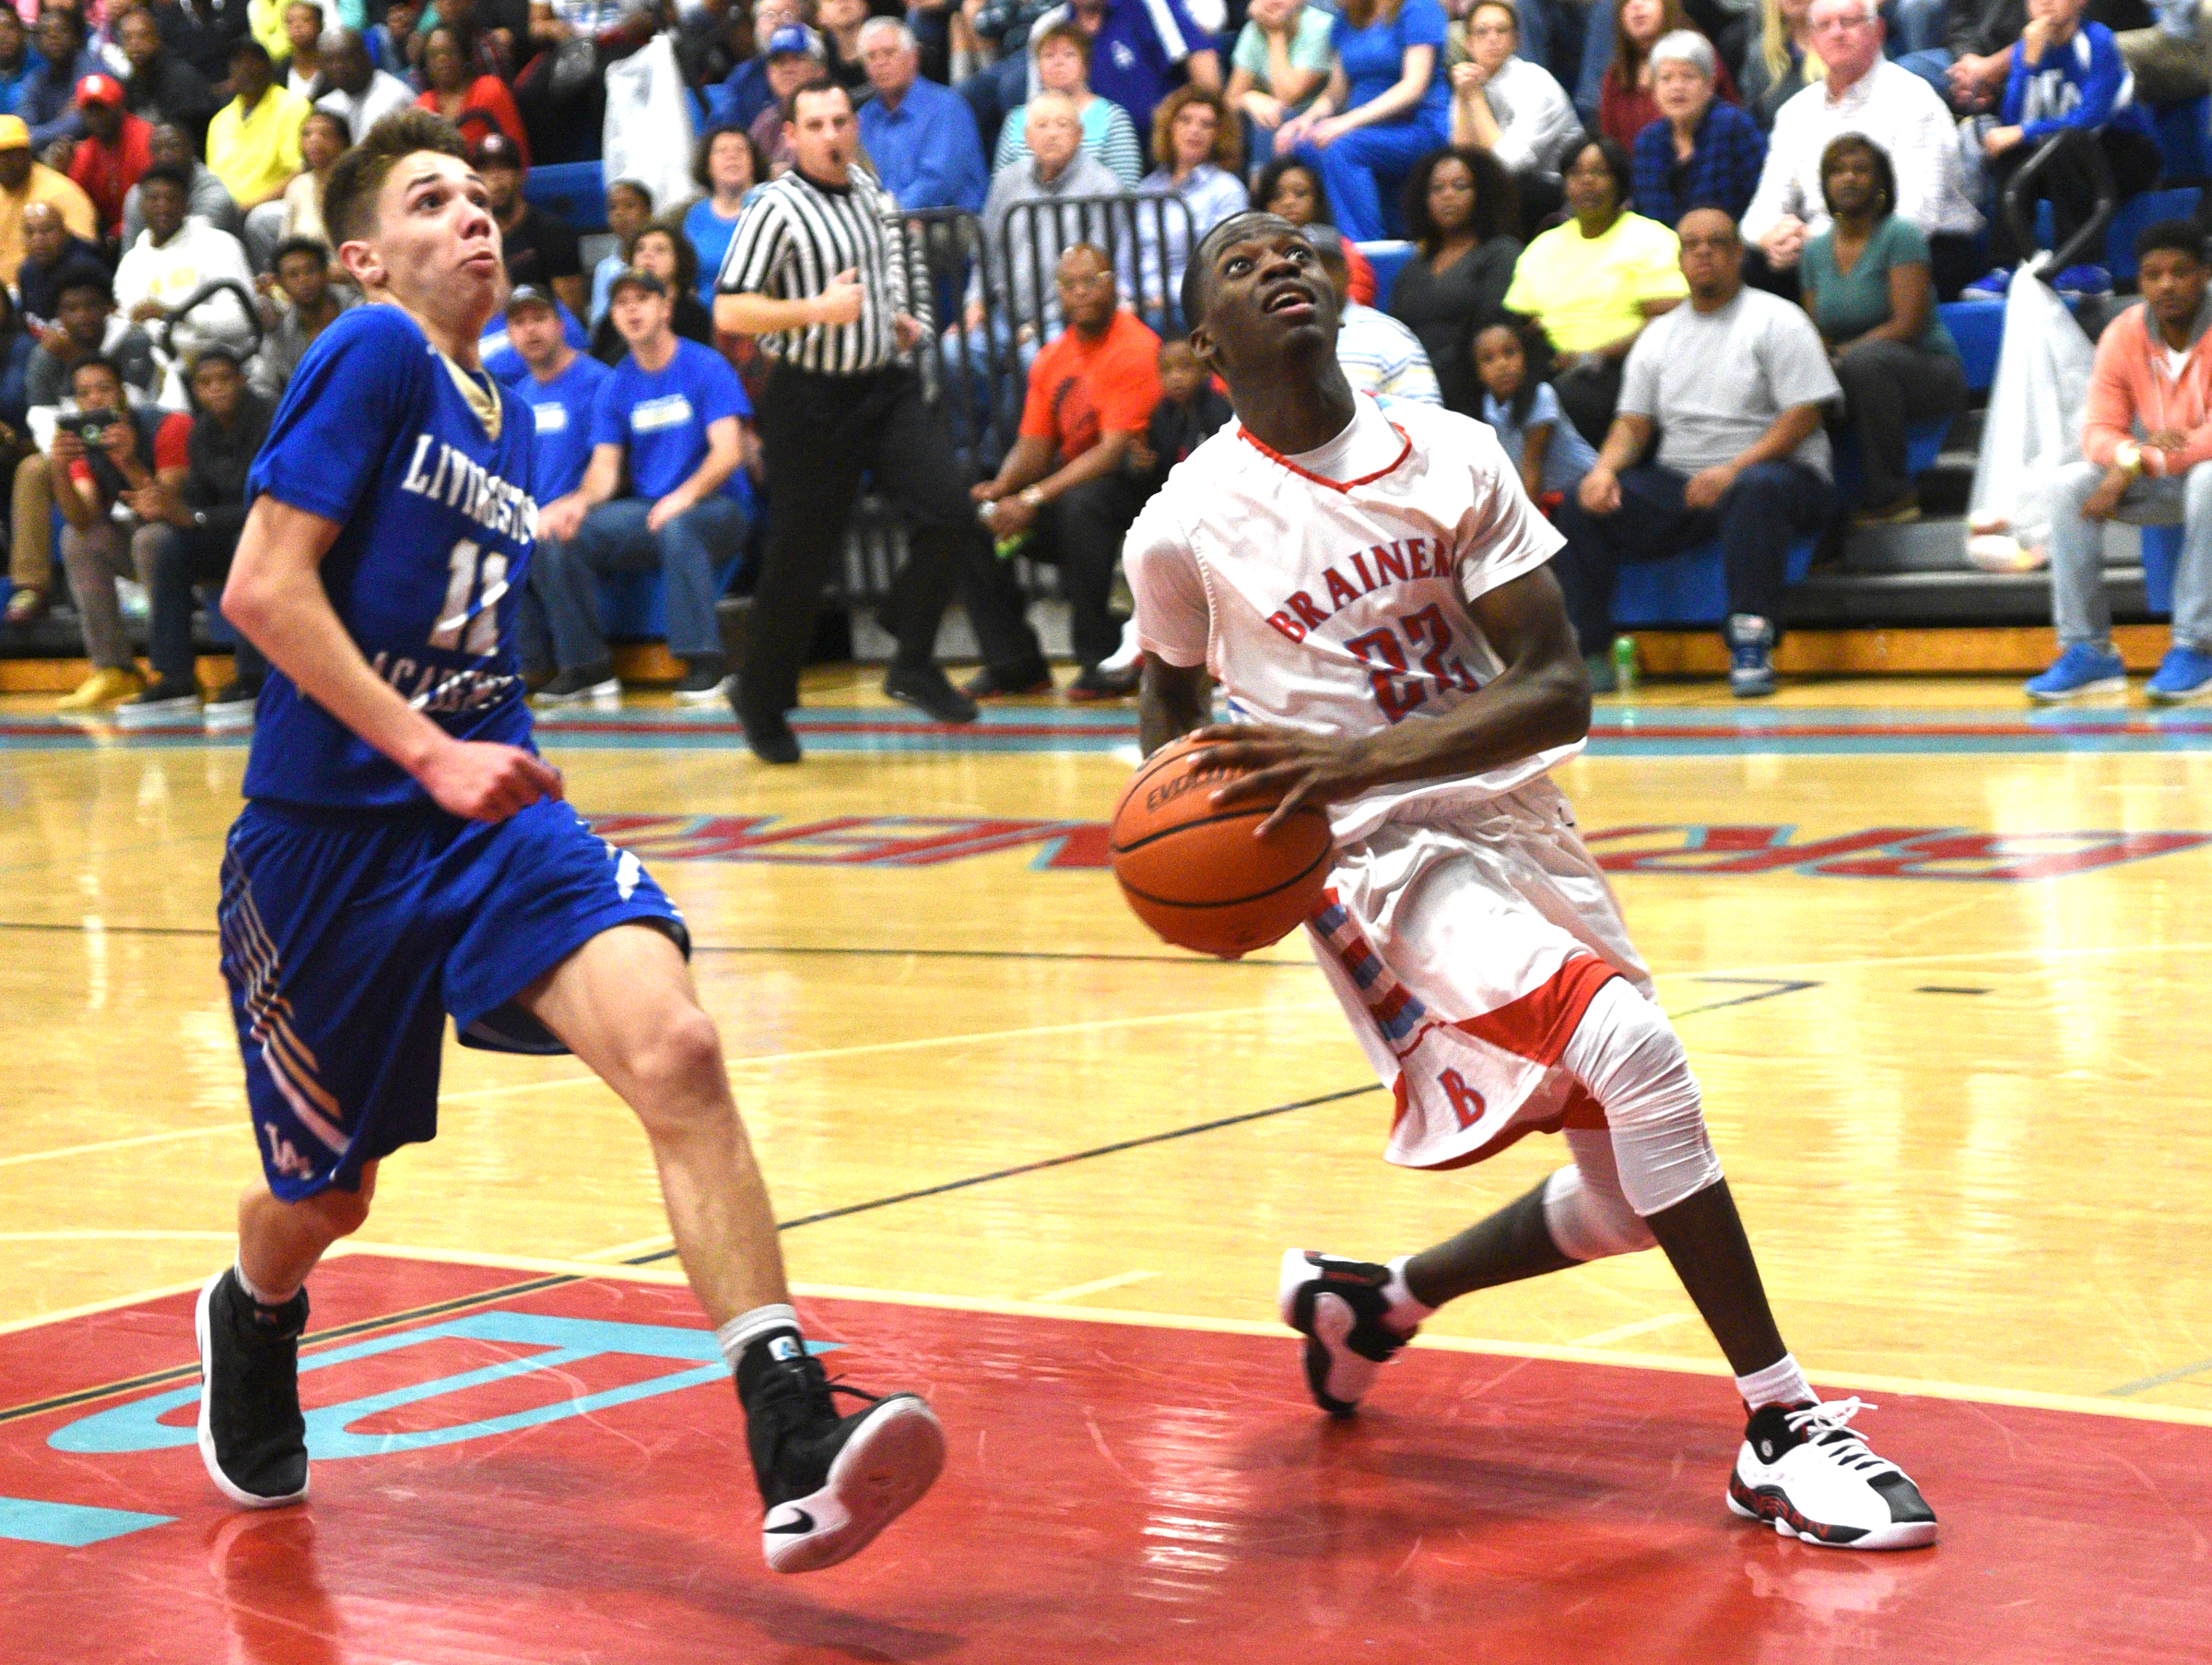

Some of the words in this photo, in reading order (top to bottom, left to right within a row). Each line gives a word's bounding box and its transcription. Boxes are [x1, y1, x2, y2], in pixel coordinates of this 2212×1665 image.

[428, 537, 509, 657] 11
[1343, 601, 1480, 726] 22
[1436, 1066, 1488, 1134] B
